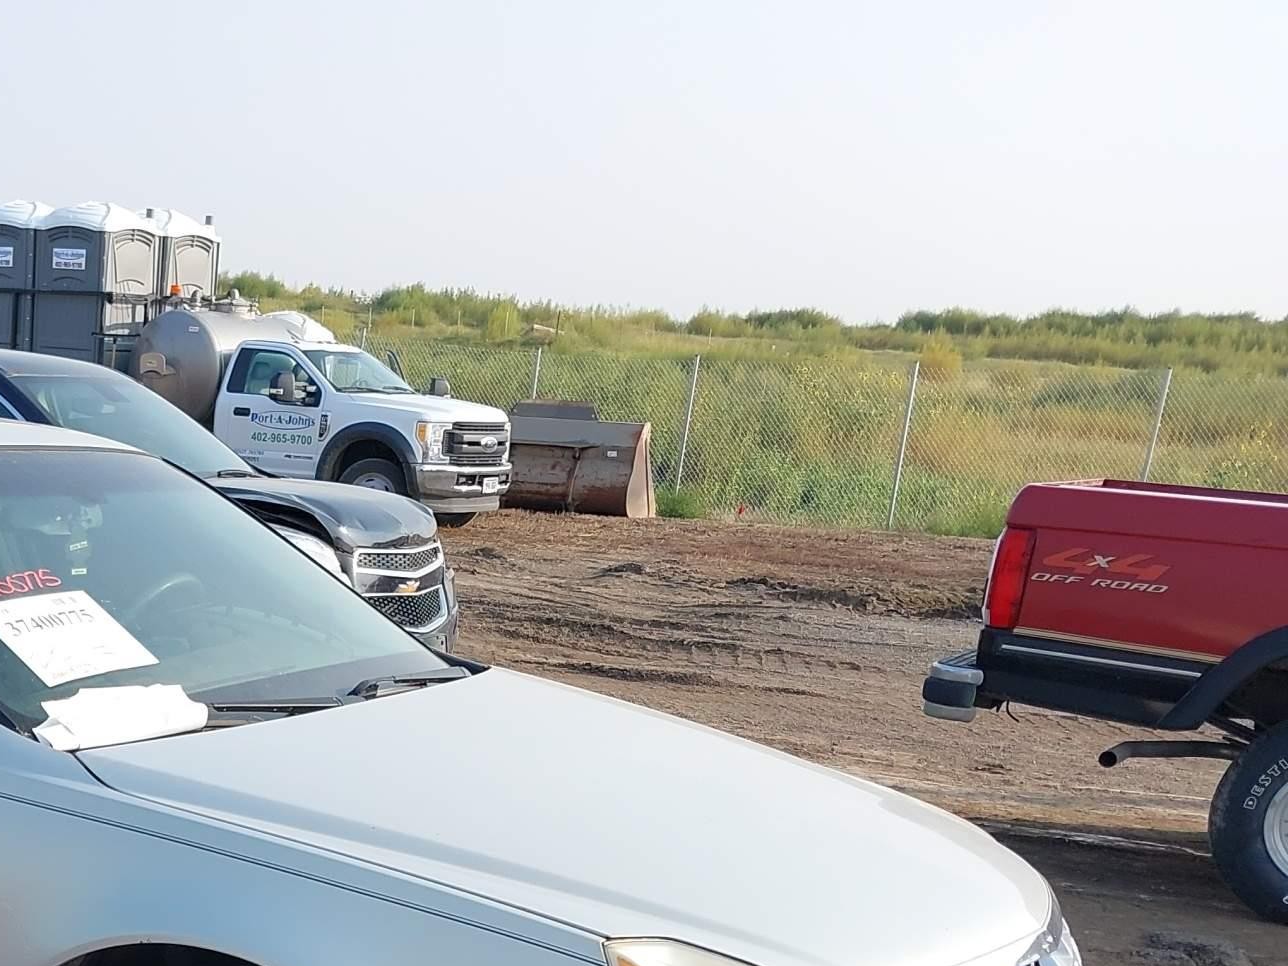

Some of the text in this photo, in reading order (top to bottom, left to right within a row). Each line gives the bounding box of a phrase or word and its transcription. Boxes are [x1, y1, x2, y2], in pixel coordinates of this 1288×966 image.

[251, 431, 313, 446] 402-965-9700
[1031, 571, 1170, 594] OFF ROAD
[4, 608, 96, 637] 37400775
